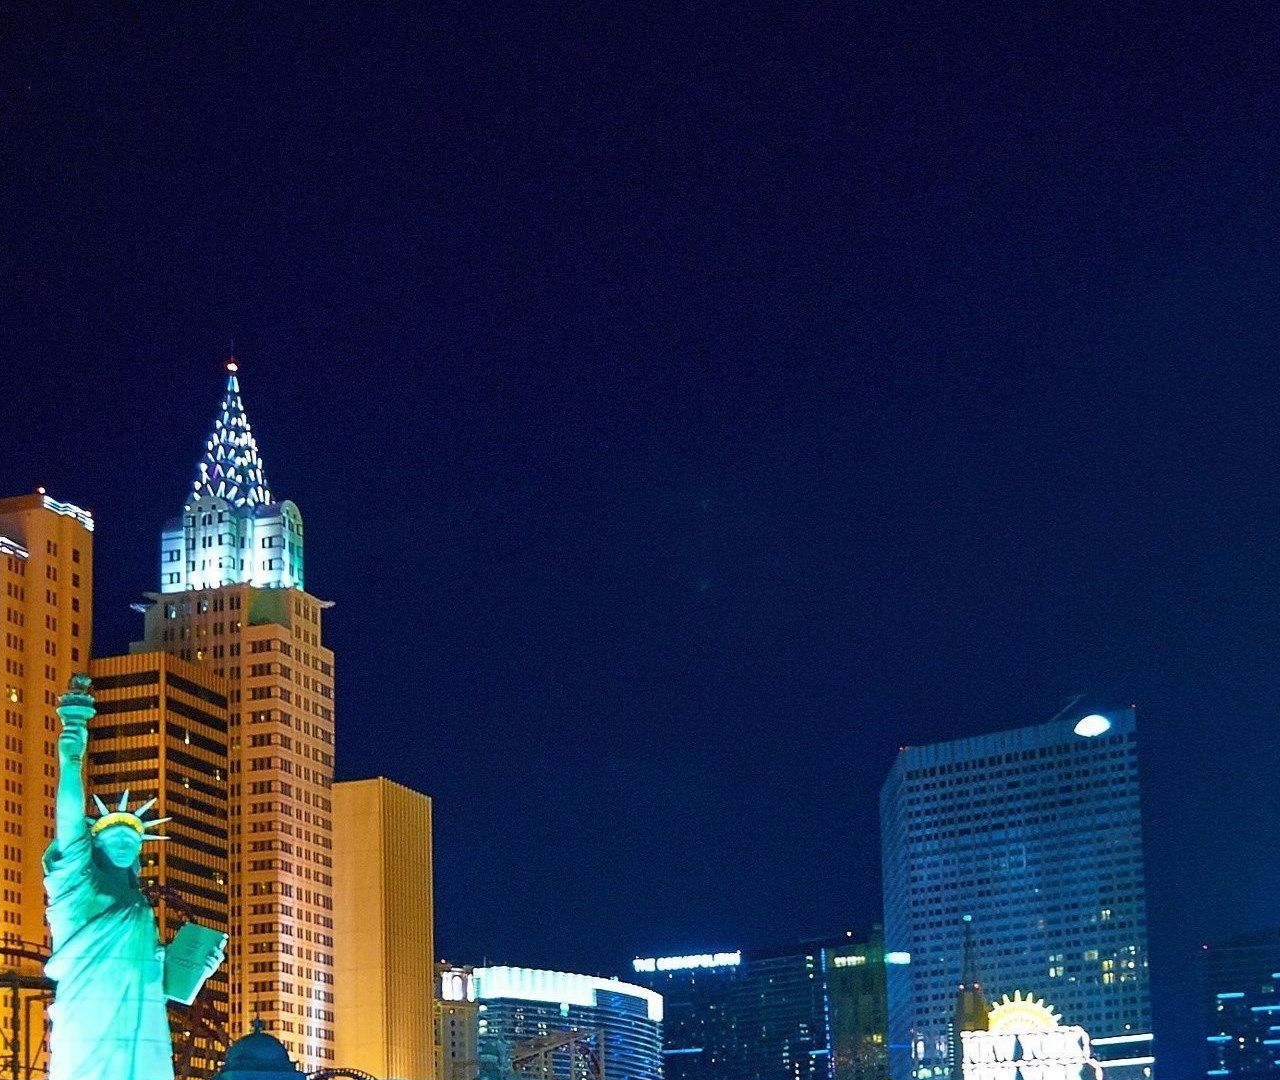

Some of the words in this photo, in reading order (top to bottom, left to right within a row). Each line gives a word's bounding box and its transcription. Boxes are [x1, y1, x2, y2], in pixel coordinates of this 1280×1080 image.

[633, 957, 656, 972] THE
[962, 1034, 1016, 1064] NEW
[1017, 1031, 1083, 1061] YORK
